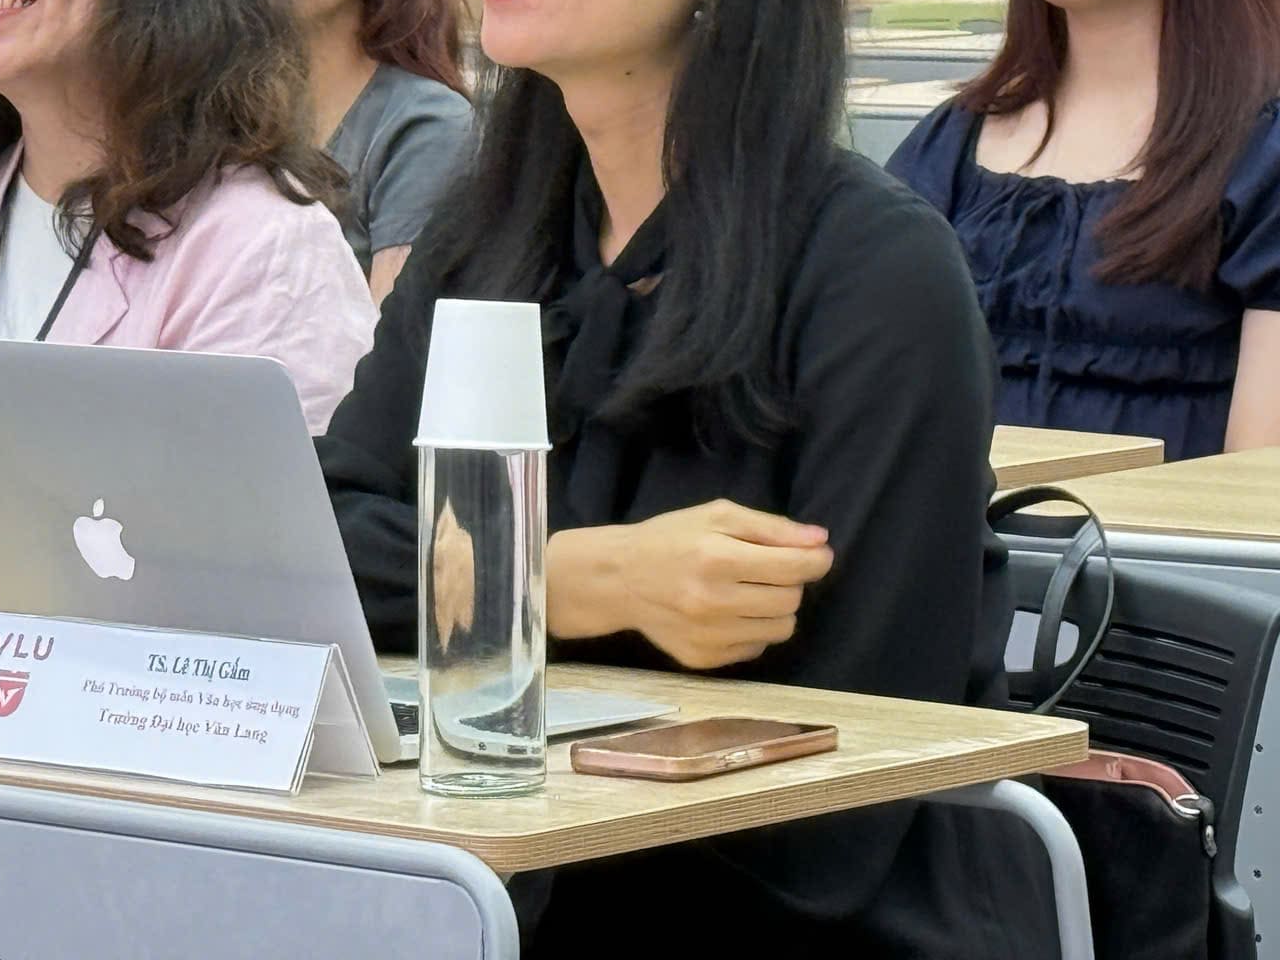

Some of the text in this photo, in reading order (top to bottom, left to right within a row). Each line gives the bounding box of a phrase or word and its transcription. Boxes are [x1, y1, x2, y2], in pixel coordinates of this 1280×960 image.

[172, 656, 190, 675] Lê
[176, 717, 201, 737] học
[233, 723, 268, 744] Lang
